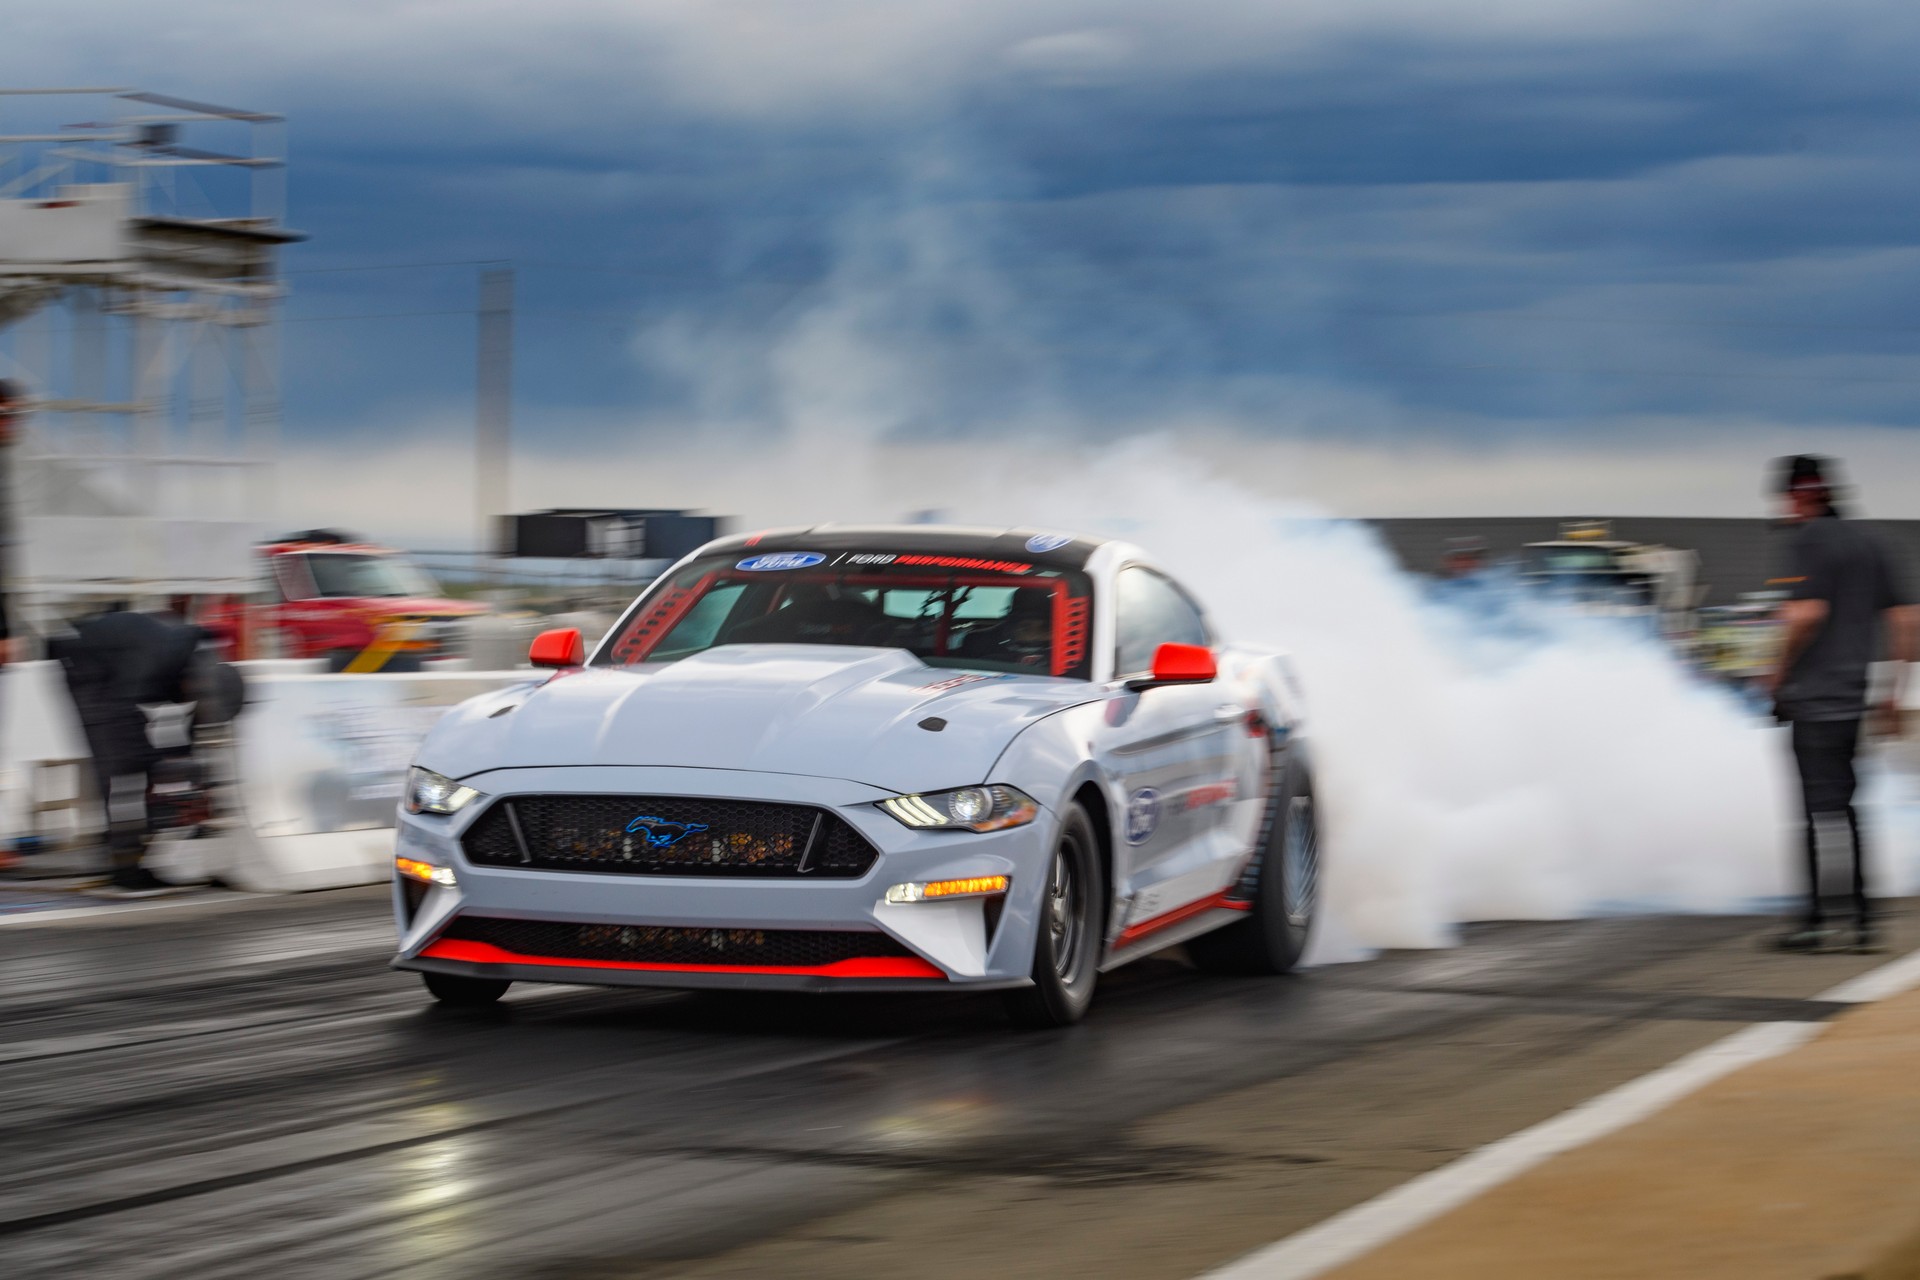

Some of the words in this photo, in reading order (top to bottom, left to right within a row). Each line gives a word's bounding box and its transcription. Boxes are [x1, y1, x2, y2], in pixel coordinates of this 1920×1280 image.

[750, 552, 811, 569] Ford
[846, 553, 897, 565] FORD
[893, 554, 1033, 572] PERFORMANCE
